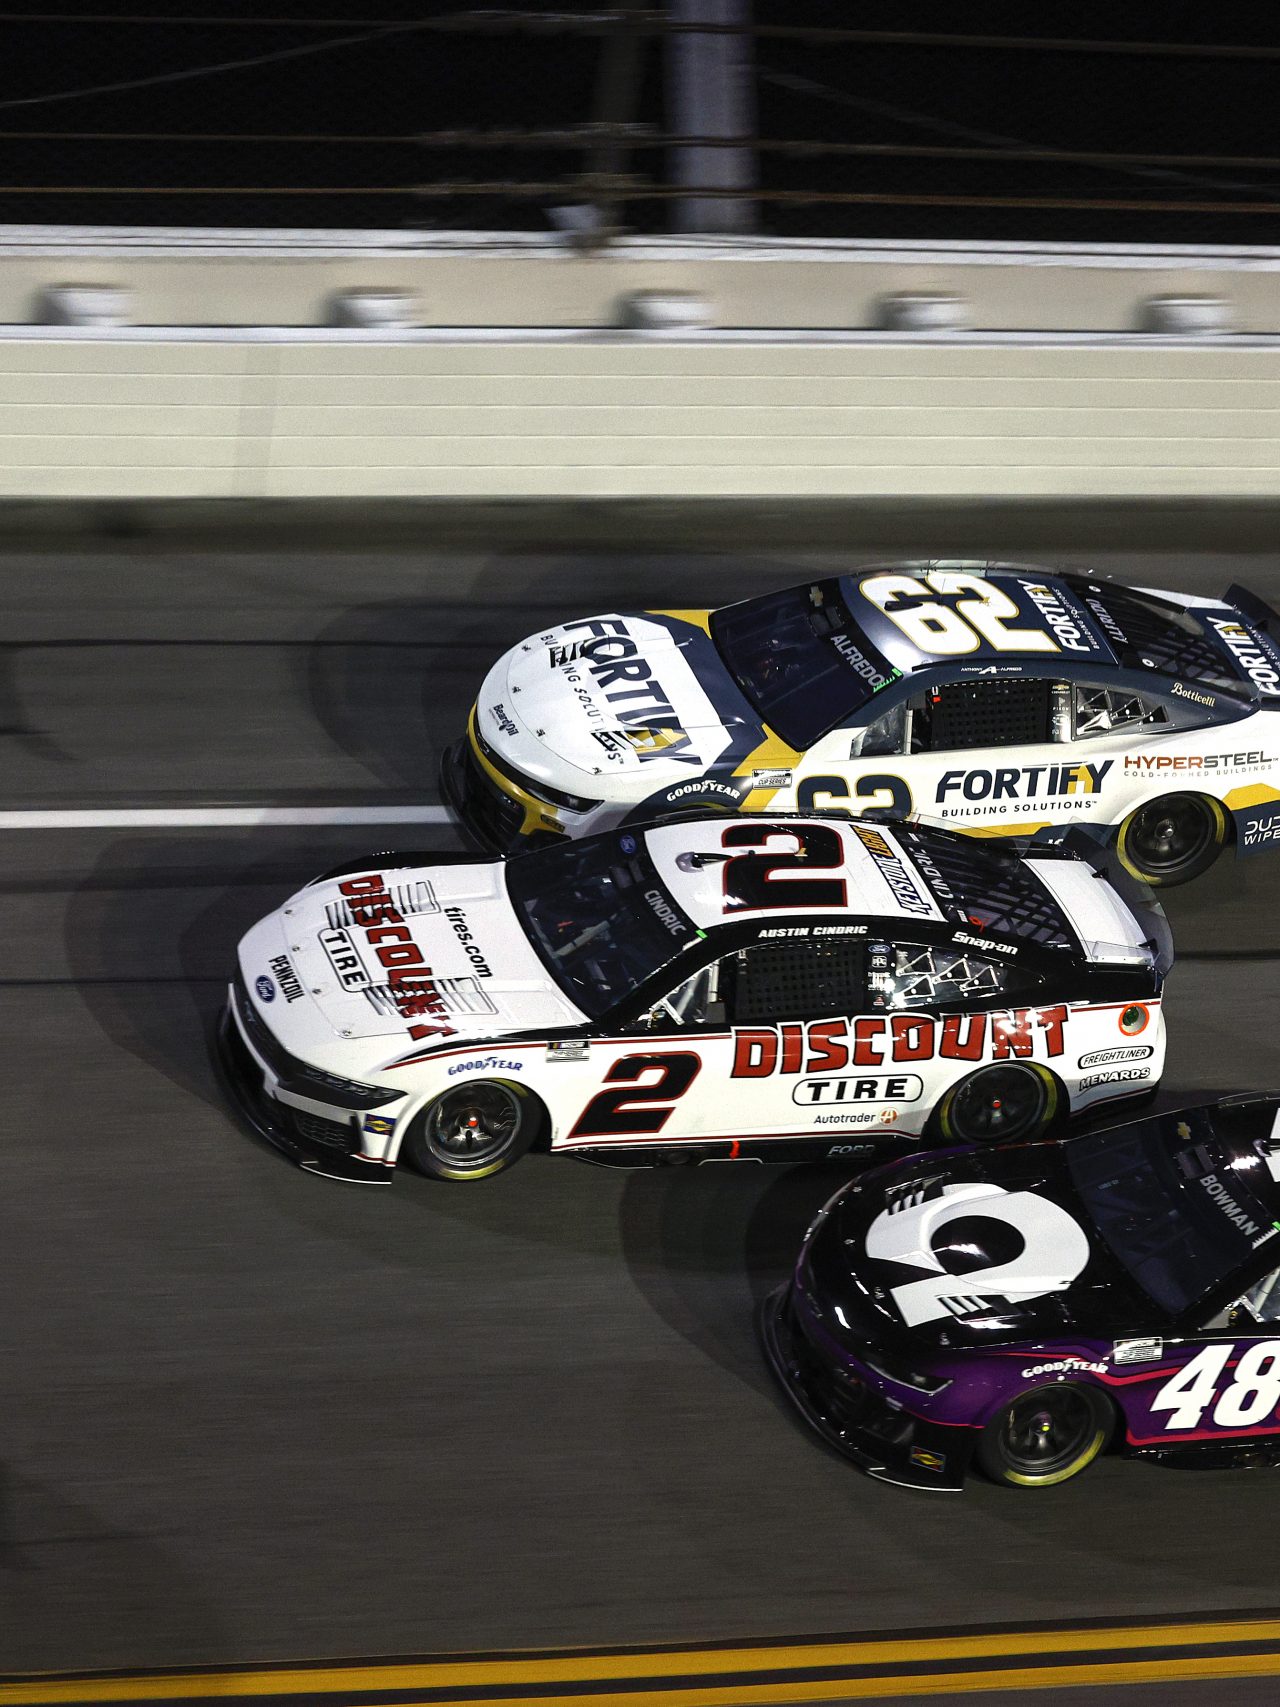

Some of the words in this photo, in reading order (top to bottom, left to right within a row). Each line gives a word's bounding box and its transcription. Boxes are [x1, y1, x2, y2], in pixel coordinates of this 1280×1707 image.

[859, 573, 1062, 655] 62
[1017, 579, 1090, 652] FORTIFY
[831, 633, 885, 689] ALFREDO
[1170, 682, 1216, 708] Botticelli
[667, 780, 741, 802] GOODYEAR
[934, 759, 1115, 804] FORTIFY
[941, 803, 1007, 818] BUILDING
[721, 823, 848, 914] 2
[644, 889, 688, 936] CINDRIC
[758, 927, 808, 938] AUSTIN
[813, 926, 868, 935] CINDRIC
[325, 931, 366, 986] TIRE
[338, 875, 461, 1041] DISCOUNT
[444, 906, 493, 978] tires.com
[952, 931, 1018, 955] Snap-on
[268, 954, 306, 1003] PENNZOIL
[730, 1004, 1069, 1078] DISCOUNT
[1083, 1049, 1147, 1065] FREIGHTLINER
[448, 1056, 523, 1075] GOODYEAR
[1079, 1067, 1151, 1092] MENARDS
[566, 1050, 702, 1139] 2
[806, 1078, 908, 1101] TIRE
[814, 1113, 876, 1124] Autotrader
[1200, 1174, 1260, 1236] BOWMAN
[1022, 1358, 1109, 1378] GOODYEAR
